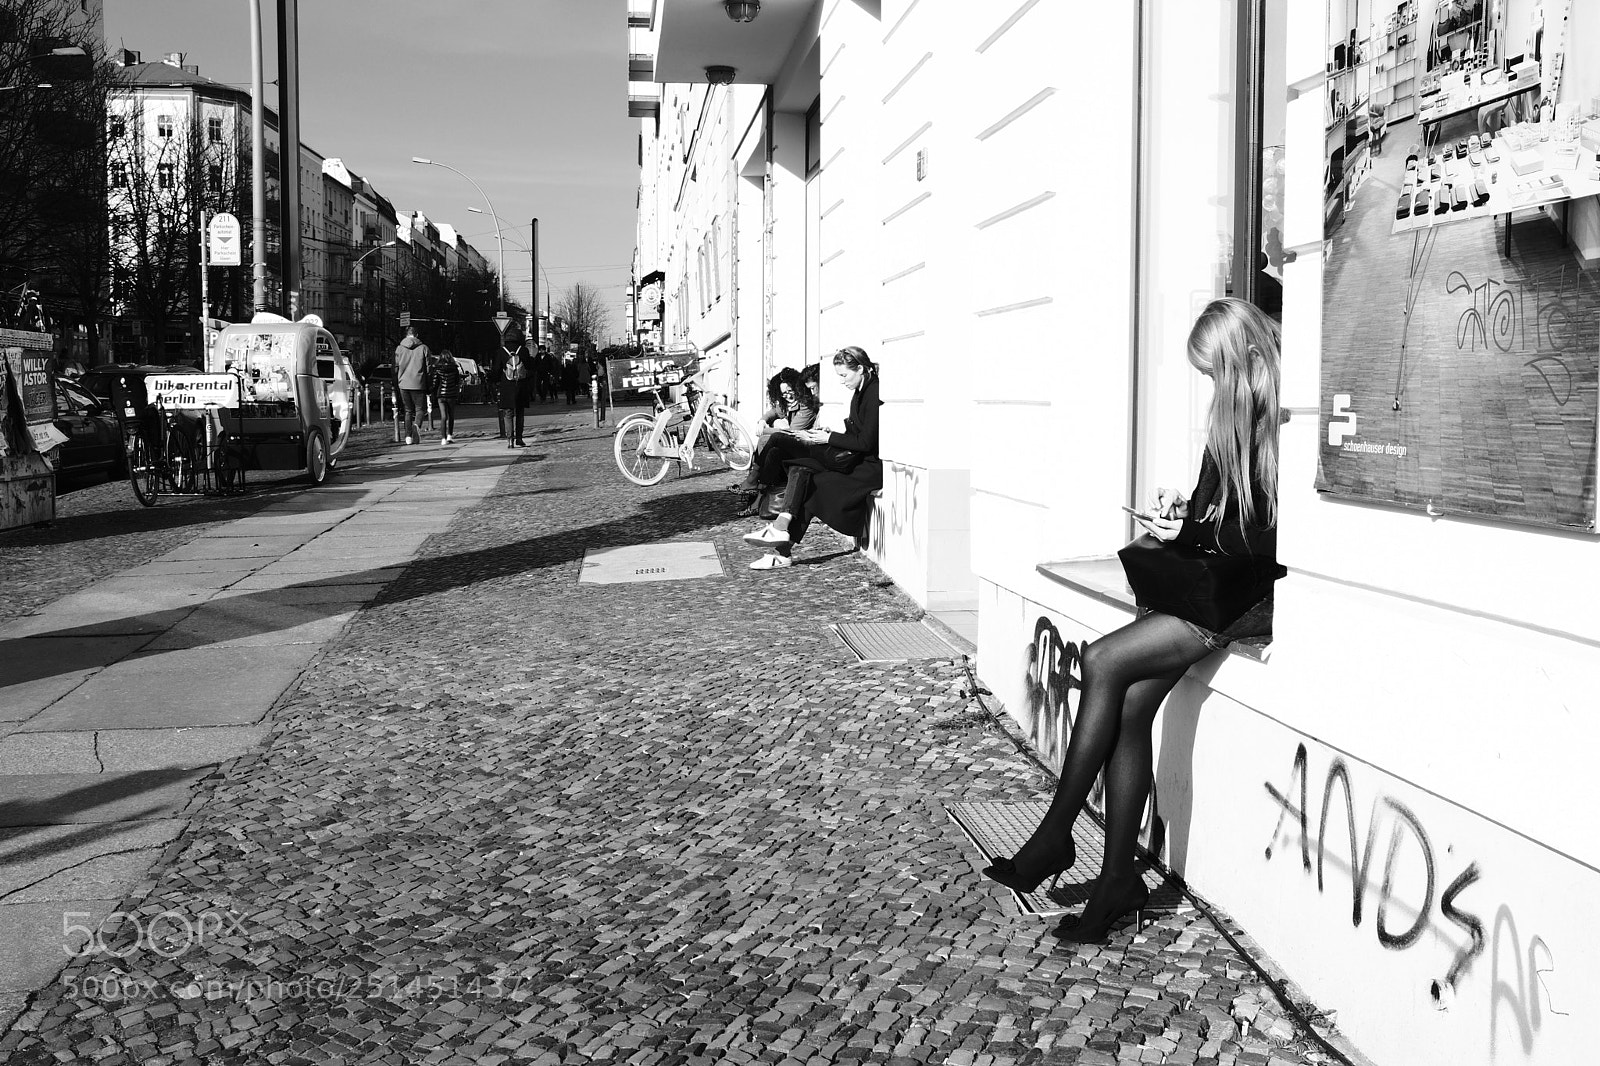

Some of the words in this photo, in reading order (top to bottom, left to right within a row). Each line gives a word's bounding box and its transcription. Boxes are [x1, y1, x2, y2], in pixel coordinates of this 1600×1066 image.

[23, 358, 48, 371] WILLY
[630, 358, 675, 373] bike
[24, 372, 47, 386] ASTOR
[622, 369, 684, 388] rental
[1343, 440, 1385, 454] schoenhauser
[1385, 442, 1407, 458] design
